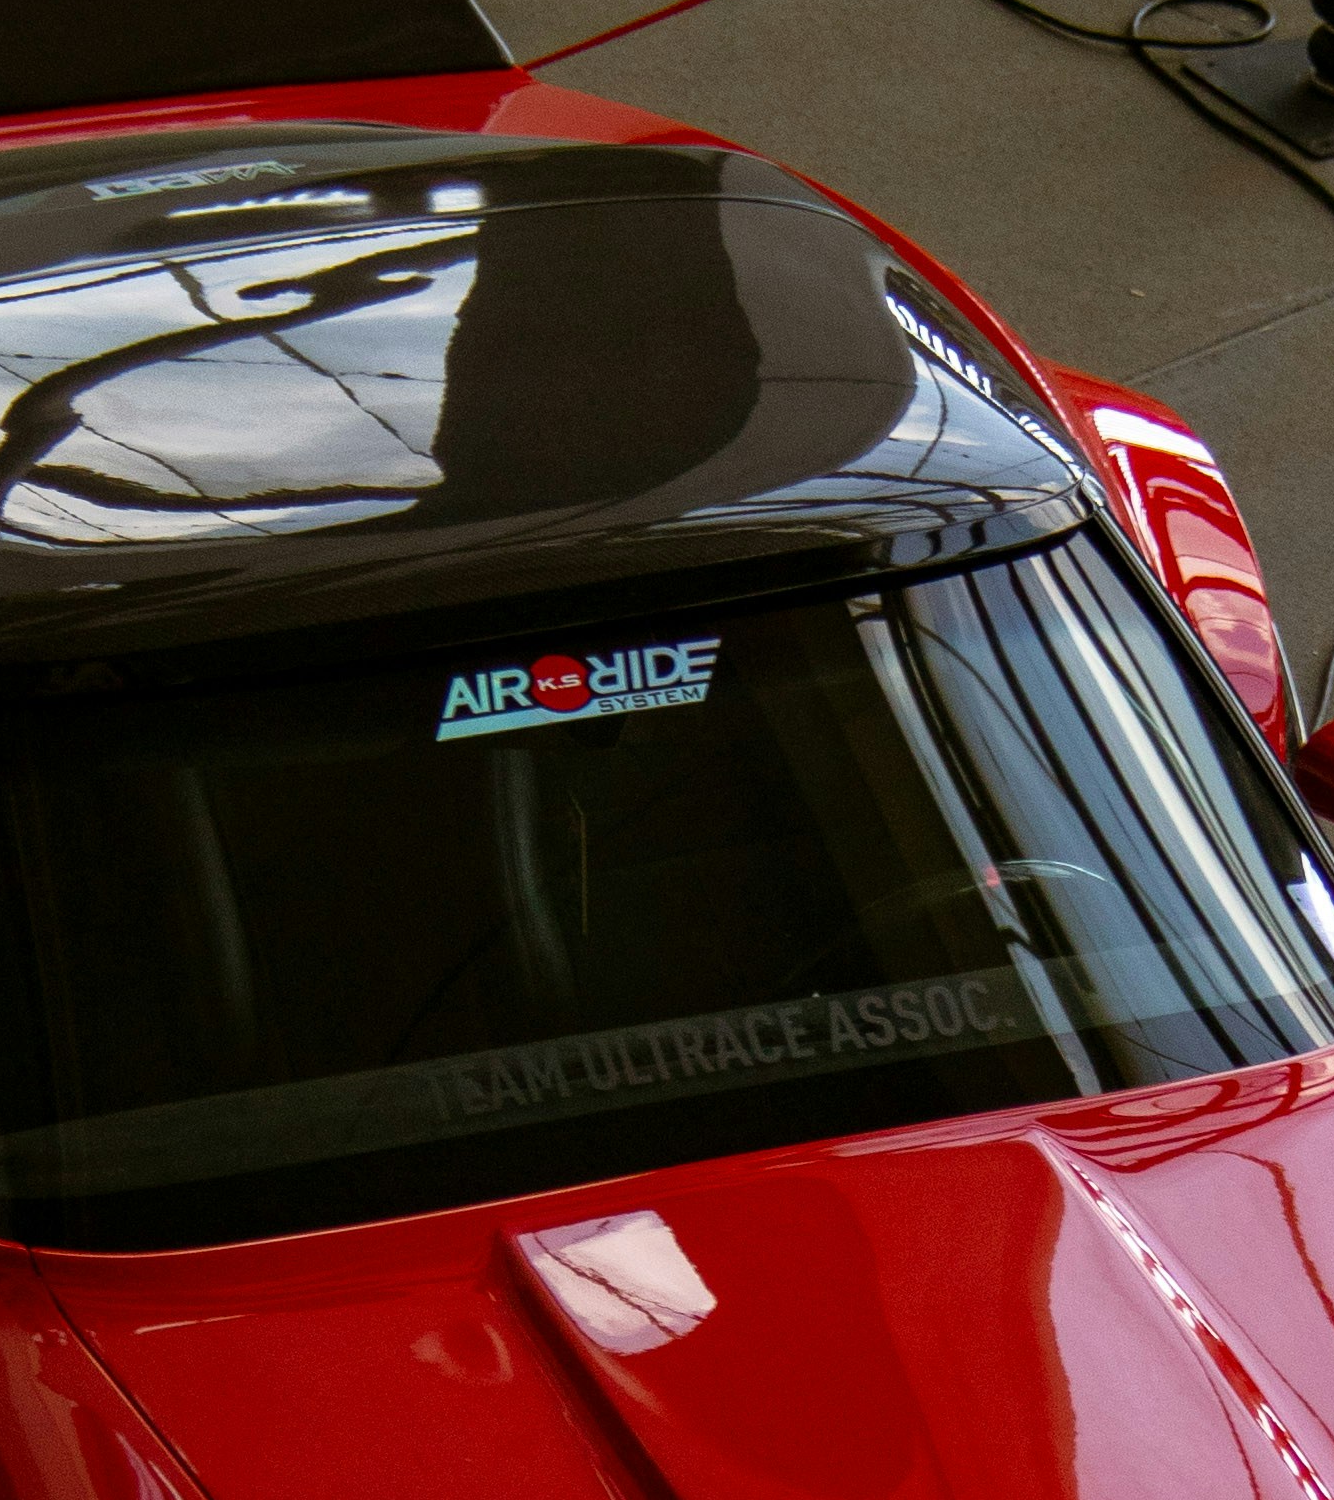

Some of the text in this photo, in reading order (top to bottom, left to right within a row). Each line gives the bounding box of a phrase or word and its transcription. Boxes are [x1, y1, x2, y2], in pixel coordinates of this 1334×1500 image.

[441, 637, 722, 719] AIR K.S RIDE
[598, 686, 702, 714] SYSTEM
[424, 979, 1017, 1121] TEAM ULTRACE ASSOC.
